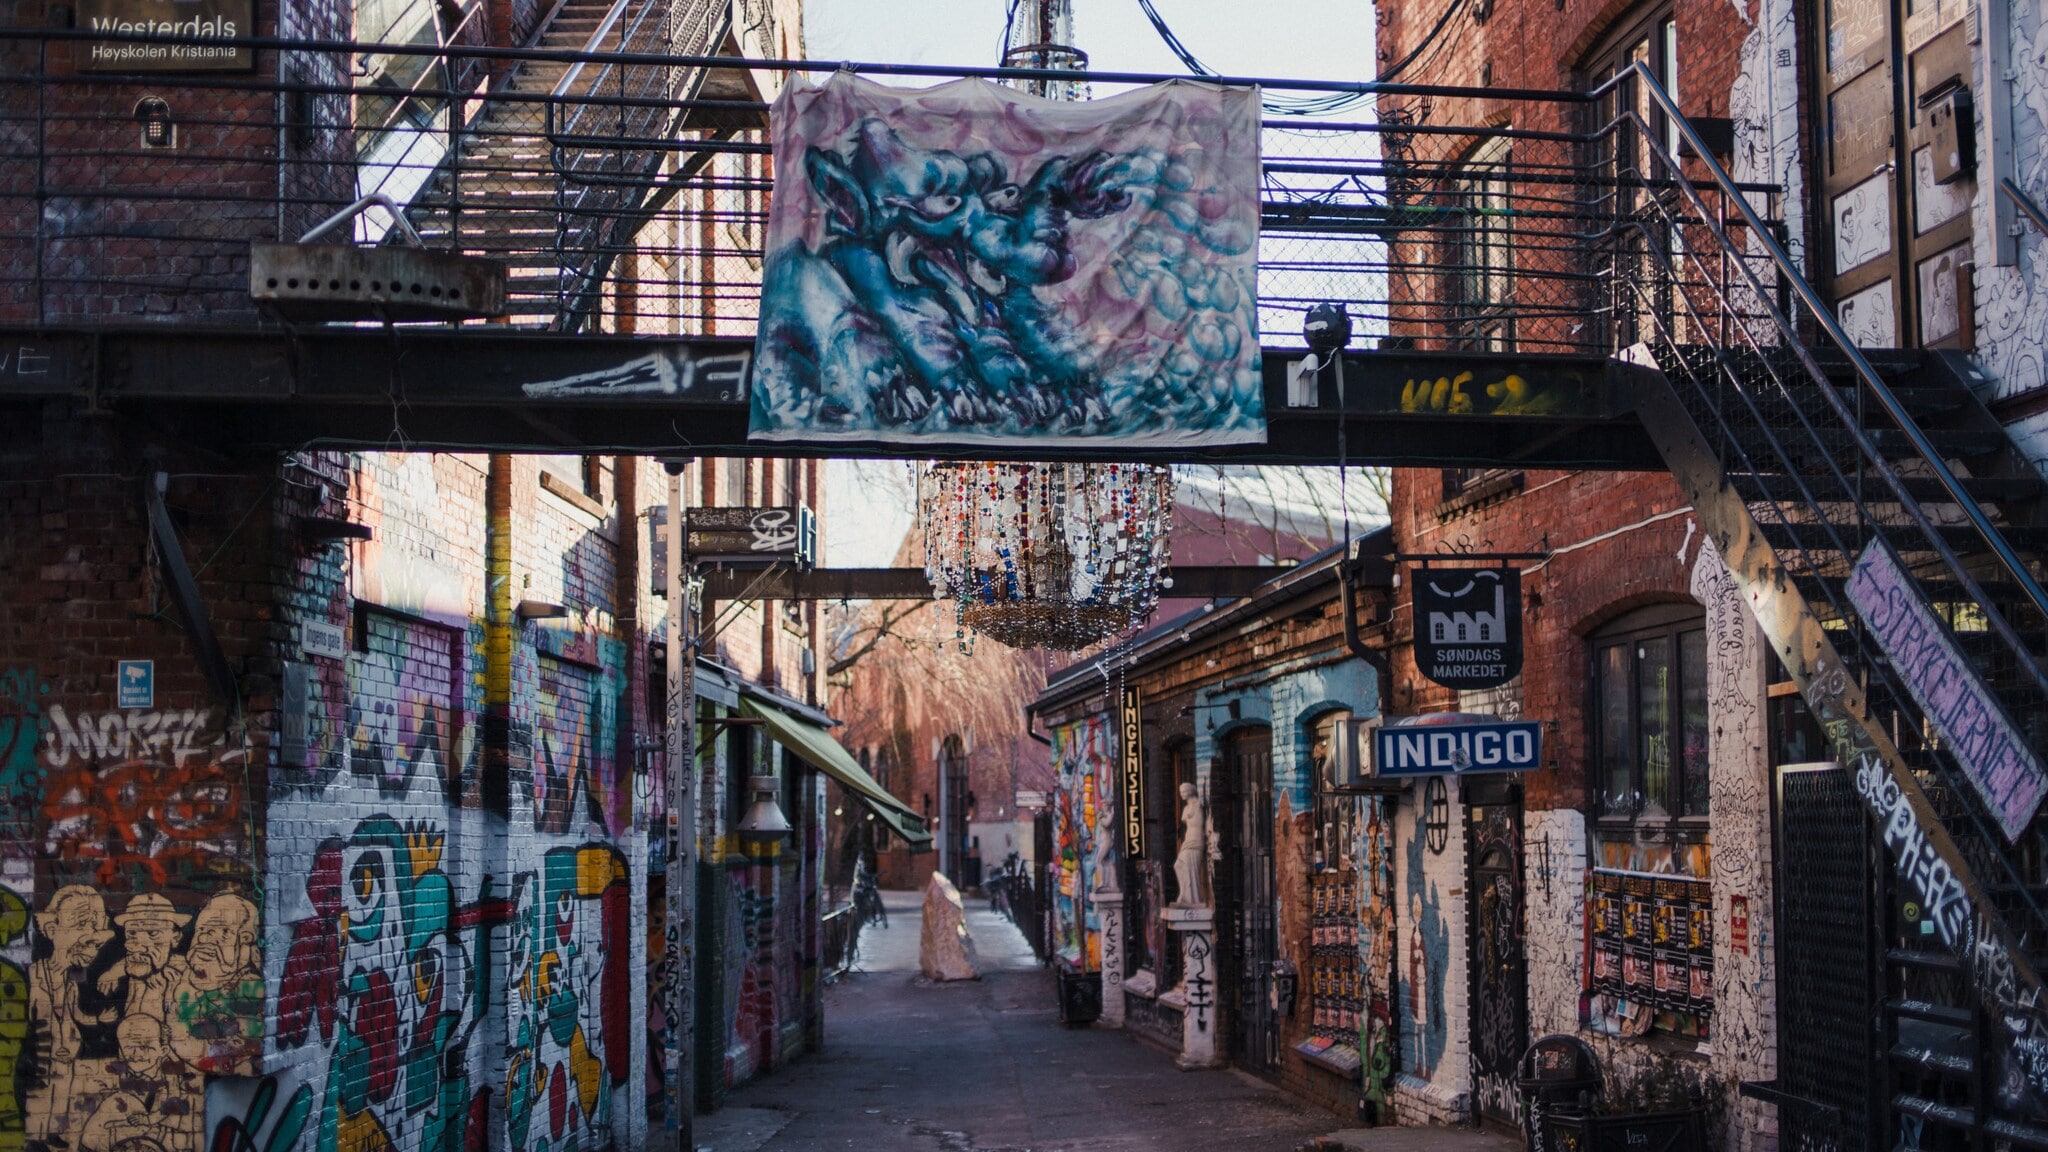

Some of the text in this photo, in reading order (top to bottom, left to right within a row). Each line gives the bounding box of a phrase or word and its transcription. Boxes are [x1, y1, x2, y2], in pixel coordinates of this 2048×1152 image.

[92, 45, 236, 62] Høyskolen Kristiania
[306, 623, 341, 652] Ingens gate
[1436, 648, 1501, 663] SØNDAGS
[1432, 664, 1507, 679] MARKEDET
[1870, 585, 2035, 811] STRYKEJERNET
[1384, 729, 1533, 769] INDIGO
[1125, 691, 1141, 855] INGENSTEDS
